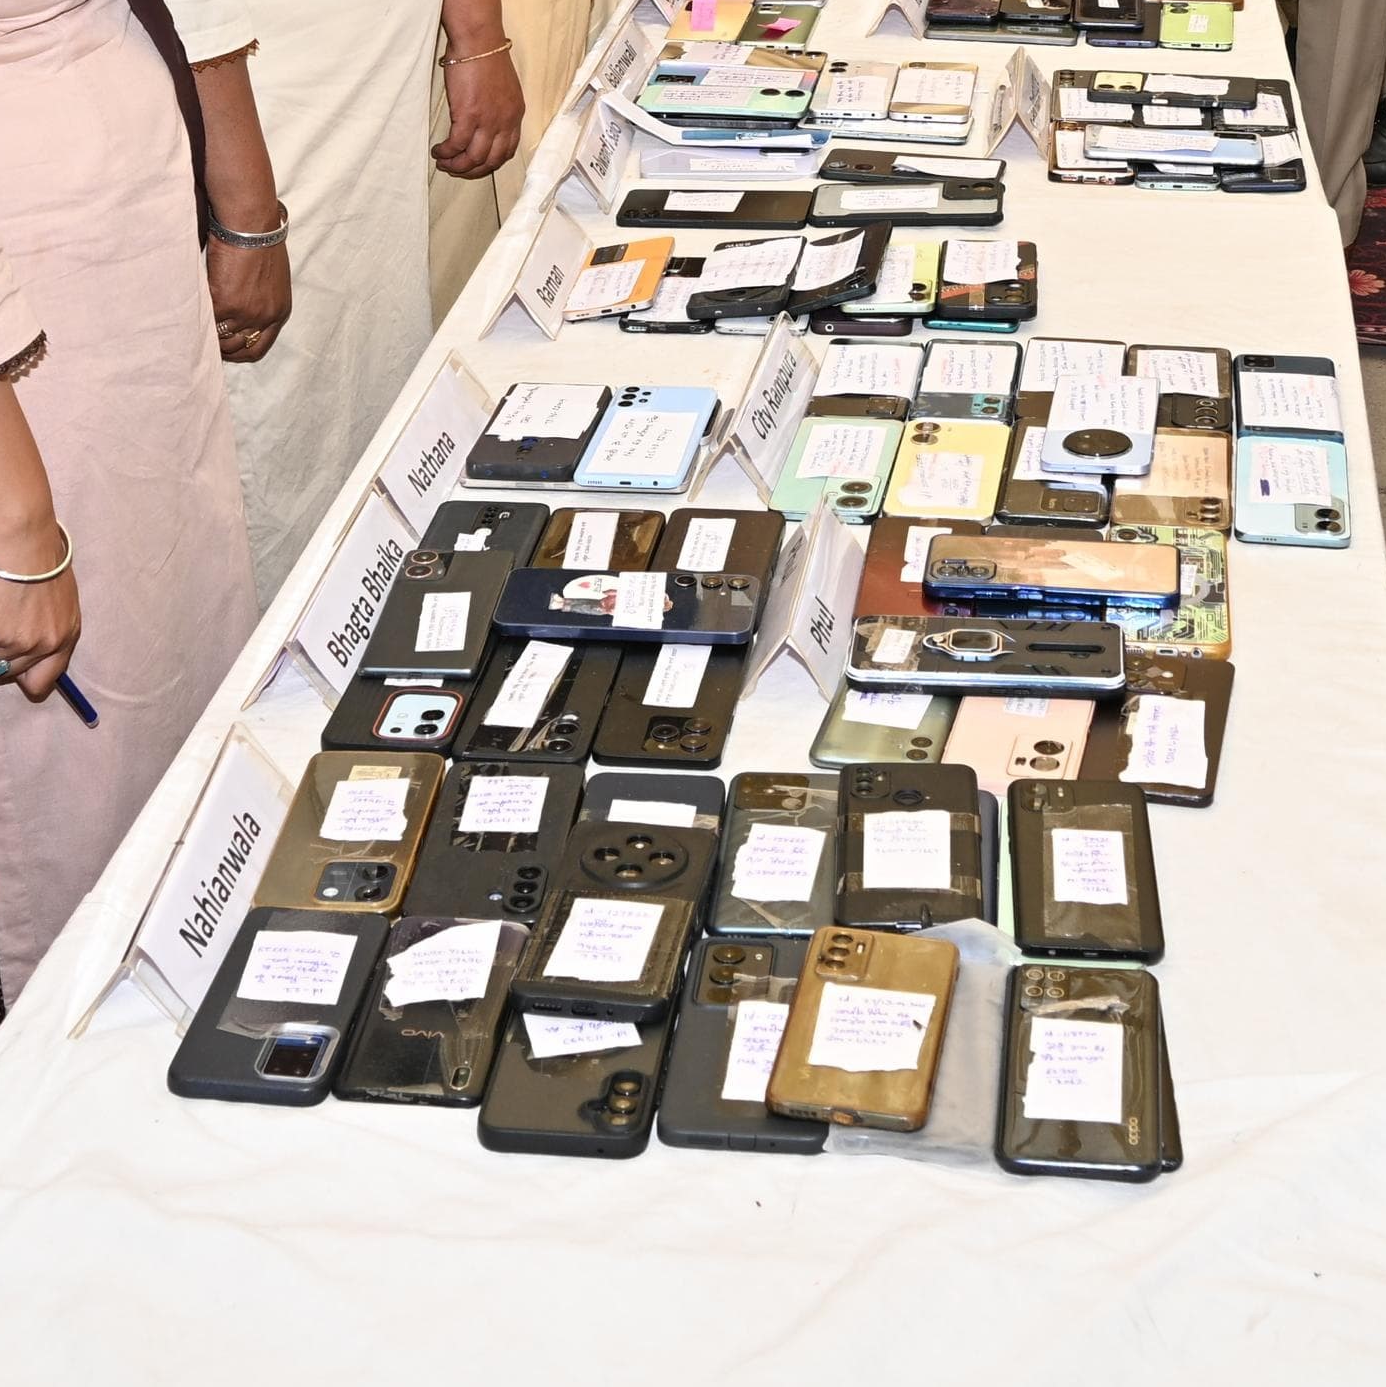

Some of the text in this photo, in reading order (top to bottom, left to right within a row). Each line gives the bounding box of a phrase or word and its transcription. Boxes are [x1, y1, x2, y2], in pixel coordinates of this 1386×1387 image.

[536, 263, 565, 309] Raman
[751, 348, 797, 440] City Rampura
[407, 431, 456, 498] Nathana
[326, 538, 404, 668] Bhagta Bhaika
[178, 812, 262, 959] Nahianwala
[400, 1029, 445, 1039] vivo
